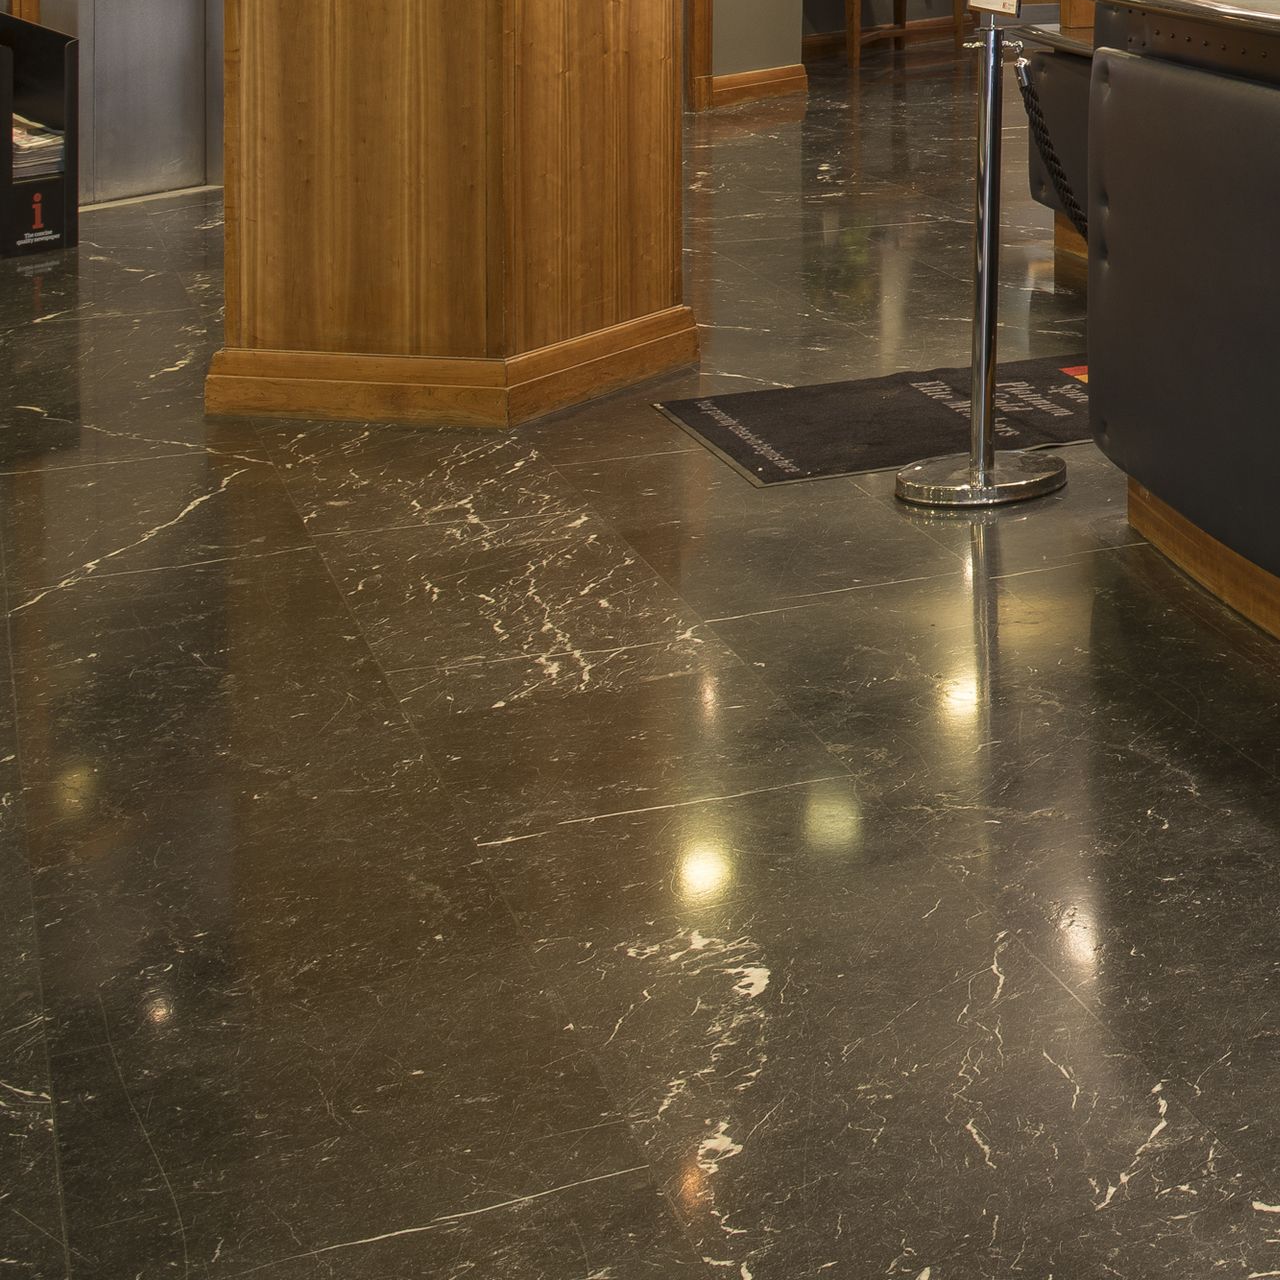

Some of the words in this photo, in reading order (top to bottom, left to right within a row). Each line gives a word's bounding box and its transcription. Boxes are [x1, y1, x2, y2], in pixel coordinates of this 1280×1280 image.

[24, 232, 34, 240] The
[34, 233, 61, 242] newspaper
[909, 380, 953, 399] Elite
[995, 381, 1074, 416] Platinum
